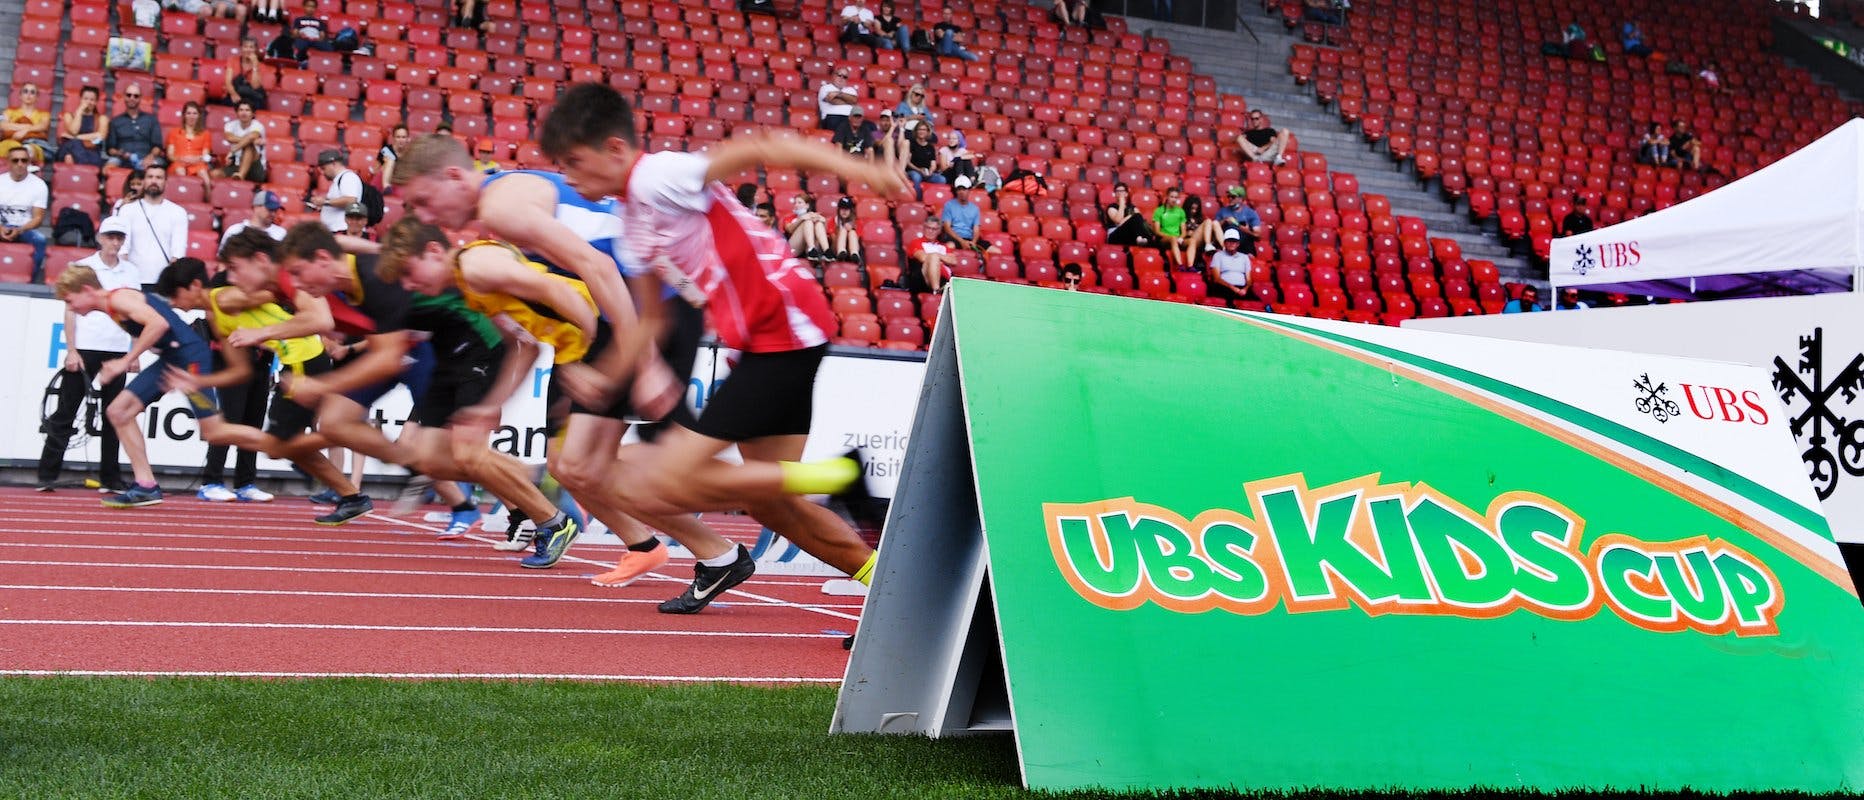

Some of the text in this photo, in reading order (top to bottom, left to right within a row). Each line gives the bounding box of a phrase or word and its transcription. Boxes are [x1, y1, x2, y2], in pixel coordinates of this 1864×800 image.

[1599, 240, 1641, 269] UBS
[1679, 383, 1769, 426] UBS
[1055, 484, 1776, 627] UBS KIDS CUP
